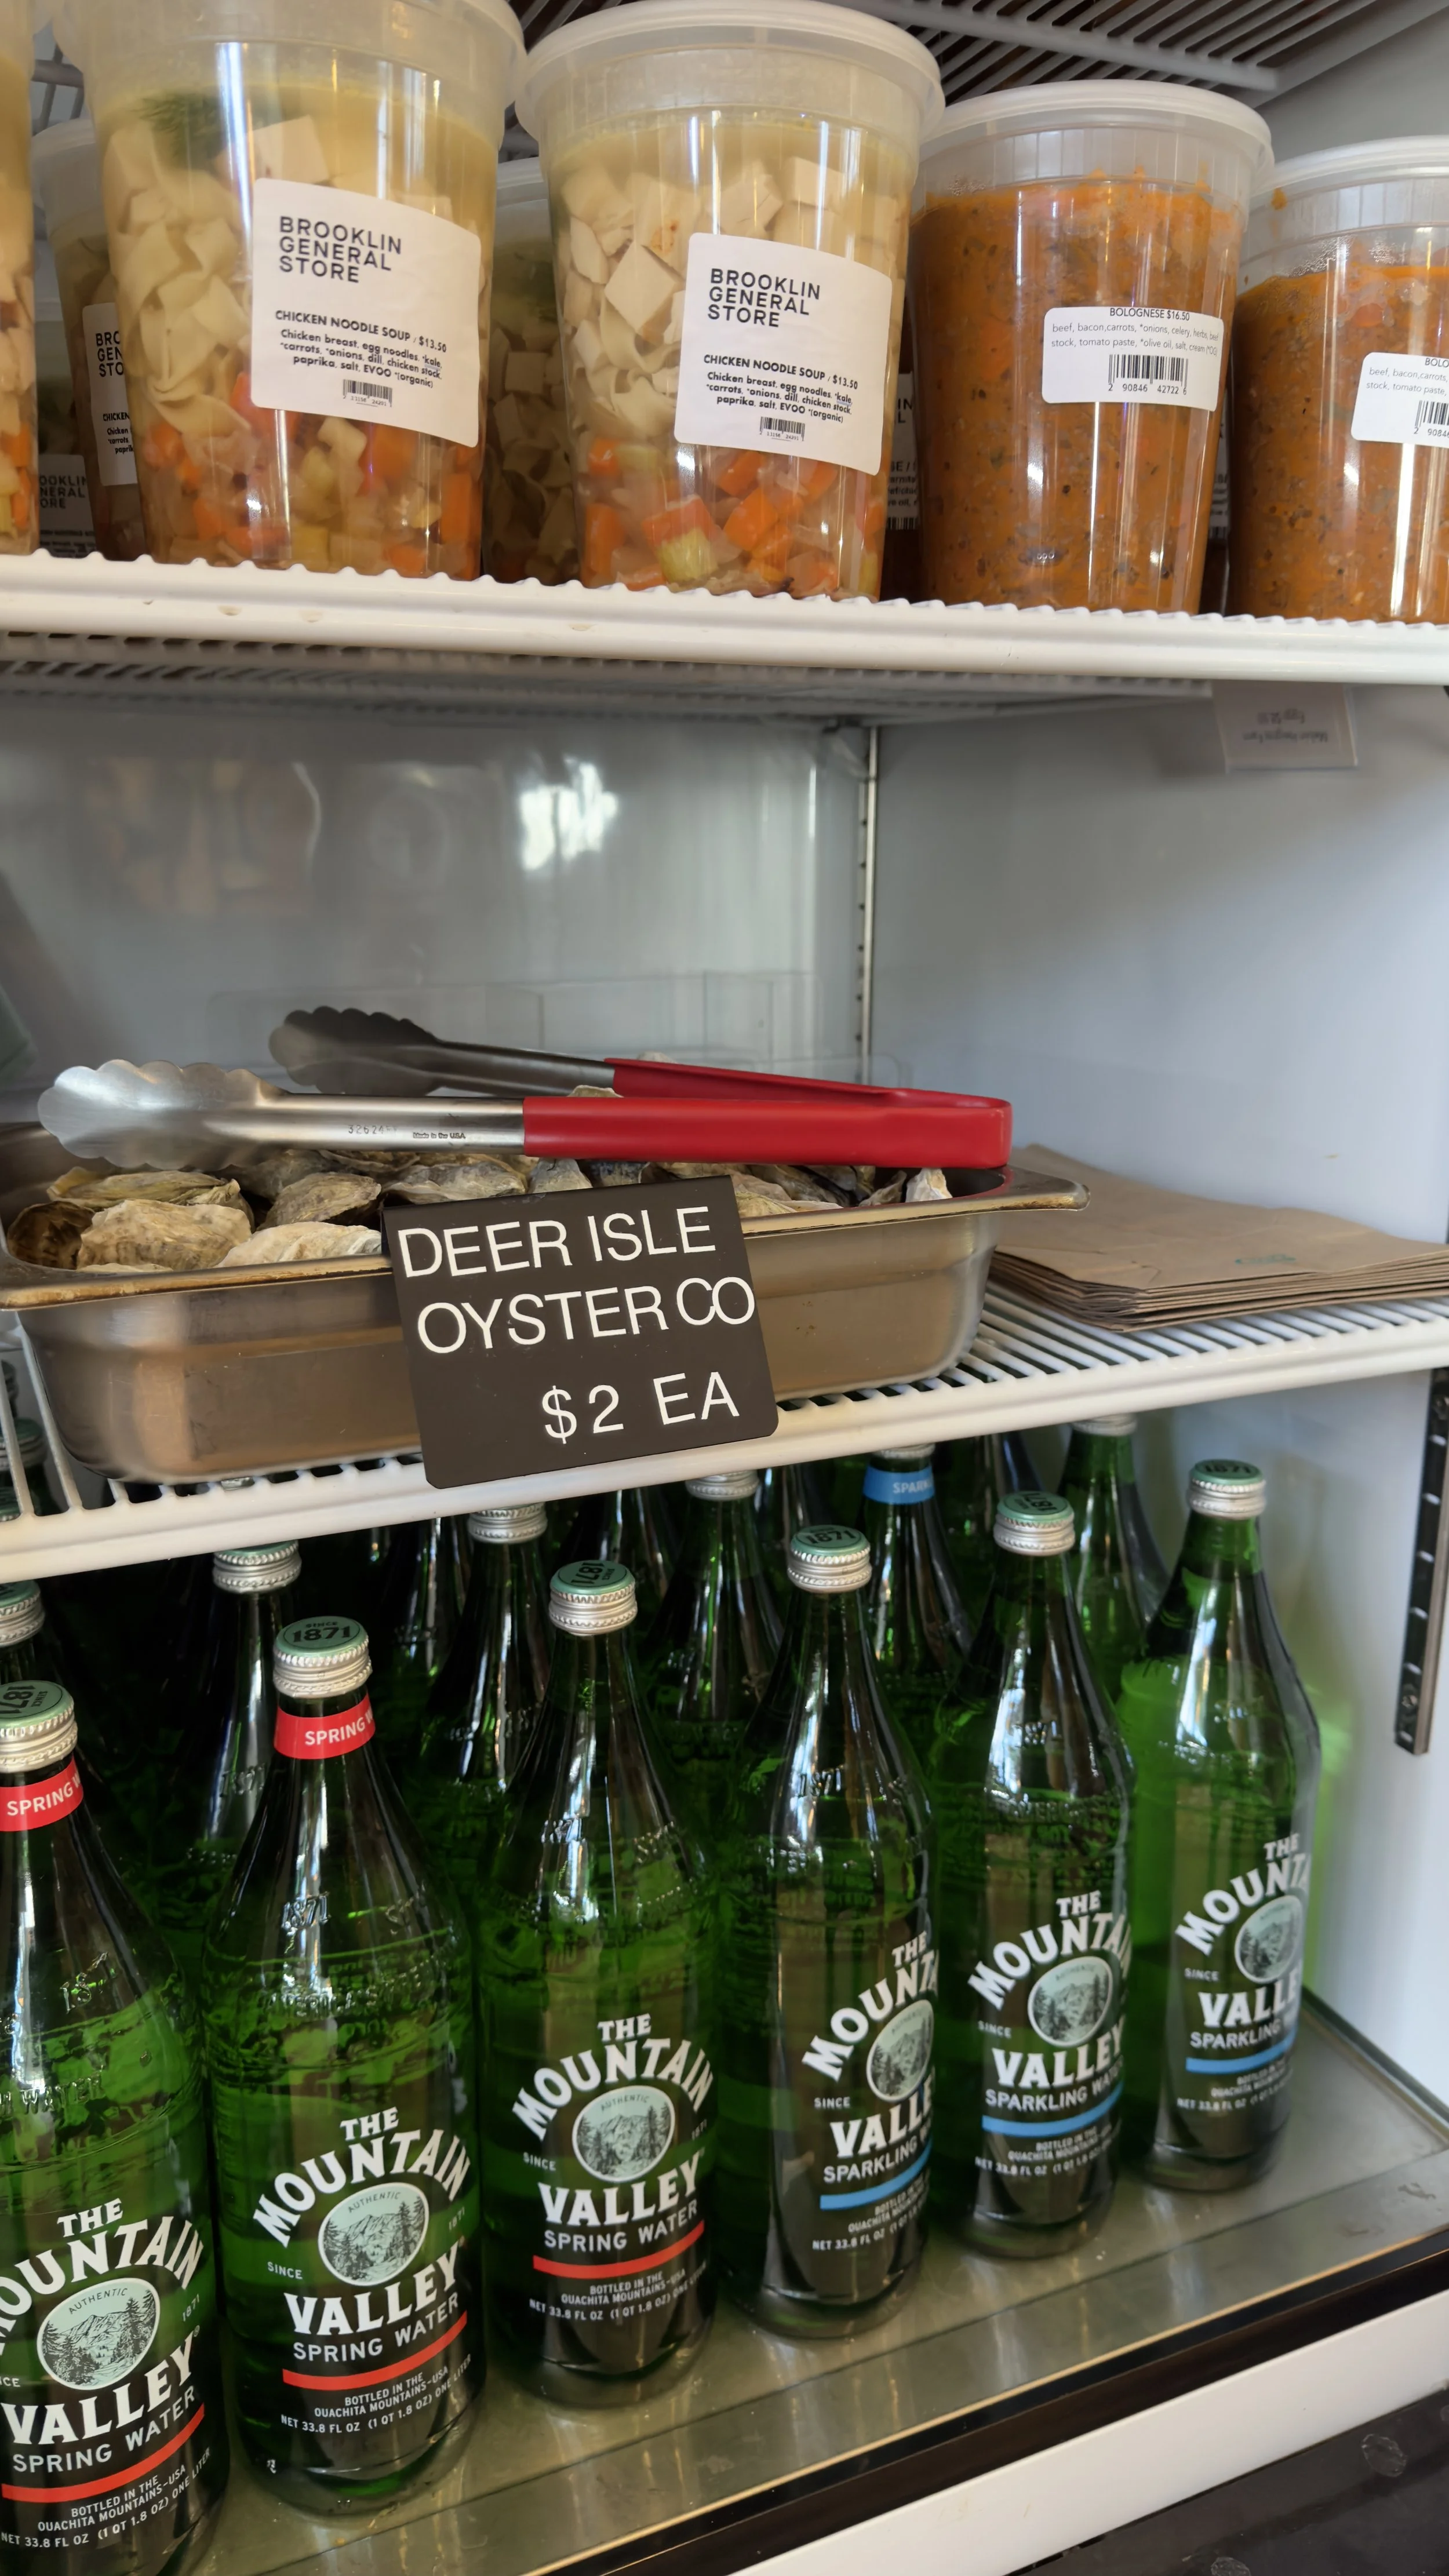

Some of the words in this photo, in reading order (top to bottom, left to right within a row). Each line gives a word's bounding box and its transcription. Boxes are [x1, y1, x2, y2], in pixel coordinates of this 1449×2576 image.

[279, 216, 402, 254] BROOKLIN
[279, 236, 392, 271] GENERAL
[279, 255, 359, 283] STORE
[710, 268, 821, 300] BROOKLIN
[709, 286, 810, 315] GENERAL
[1109, 308, 1164, 318] BOLOGNESE
[1167, 310, 1190, 321] $16.50
[708, 304, 780, 327] STORE
[275, 310, 327, 326] CHICKEN
[330, 317, 378, 335] NOODLE
[382, 326, 410, 341] SOUP
[419, 335, 447, 353] $13.50
[281, 329, 321, 343] Chicken
[325, 334, 359, 348] breast,
[362, 342, 381, 354] egg
[383, 346, 420, 362] noodles,
[1051, 338, 1076, 348] stock,
[1079, 338, 1110, 347] tomato
[1113, 338, 1137, 350] paste,
[1163, 340, 1173, 349] oil,
[1175, 342, 1187, 351] salt,
[1189, 344, 1205, 353] cream
[1052, 323, 1075, 333] beef,
[1171, 327, 1192, 338] celery,
[1193, 329, 1208, 341] herbs,
[293, 355, 337, 369] paprika,
[340, 361, 361, 373] salt,
[363, 365, 392, 378] EVOO
[368, 354, 384, 365] dill,
[387, 358, 419, 373] chicken
[421, 366, 442, 380] stock,
[704, 354, 750, 367] CHICKEN
[753, 360, 797, 375] NOODLE
[799, 367, 825, 381] SOUP
[832, 374, 858, 390] $13.50
[1369, 367, 1390, 377] beef,
[707, 371, 743, 384] Chicken
[747, 376, 778, 388] breast,
[780, 383, 797, 393] egg
[799, 386, 832, 399] noodles,
[1122, 384, 1148, 392] 90846
[1157, 385, 1179, 395] 42722
[1366, 381, 1389, 391] stock,
[1393, 384, 1421, 392] tomato
[1423, 387, 1447, 396] paste,
[716, 395, 756, 407] paprika,
[759, 400, 777, 410] salt,
[780, 403, 806, 414] EVOO
[784, 392, 800, 403] dill,
[802, 396, 832, 409] chicken
[833, 403, 852, 415] stock,
[107, 427, 129, 435] Chicken
[398, 1220, 573, 1278] DEER
[587, 1206, 716, 1262] ISLE
[417, 1285, 669, 1353] OYSTER
[676, 1276, 755, 1326] CO
[541, 1385, 624, 1444] $2
[653, 1371, 740, 1425] EA
[806, 1531, 857, 1544] 1871
[570, 1562, 605, 1584] 1871
[293, 1625, 350, 1642] 1871
[31, 1691, 48, 1707] SINCE
[305, 1717, 366, 1746] SPRING
[7, 1782, 74, 1816] SPRING
[1264, 1833, 1299, 1861] THE
[1055, 1890, 1101, 1918] THE
[891, 1930, 928, 1968] THE
[597, 2013, 651, 2043] THE
[1190, 2019, 1281, 2050] SPARKLING
[992, 2016, 1124, 2089] VALLEY
[512, 2038, 714, 2142] MOUNTAIN
[814, 2097, 850, 2109] SINCE
[985, 2086, 1087, 2111] SPARKLING
[340, 2106, 399, 2141] THE
[523, 2151, 556, 2171] SINCE
[824, 2135, 918, 2184] SPARKLING
[253, 2129, 471, 2248] MOUNTAIN
[348, 2191, 401, 2213] AUTHENTIC
[537, 2151, 701, 2227] VALLEY
[57, 2198, 123, 2237] THE
[544, 2229, 627, 2253] SPRING
[638, 2199, 697, 2245] WATER
[267, 2261, 303, 2280] SINCE
[589, 2281, 631, 2296] BOTTLED
[634, 2277, 645, 2288] IN
[646, 2271, 663, 2284] THE
[69, 2288, 128, 2314] AUTHENTIC
[283, 2240, 459, 2335] VALLEY
[561, 2293, 609, 2305] OUACHITA
[182, 2293, 200, 2322] 1871
[293, 2338, 383, 2363] SPRING
[394, 2291, 458, 2347] WATER
[1, 2330, 194, 2445] VALLEY
[281, 2414, 298, 2428] NET
[301, 2421, 326, 2433] 33.8
[329, 2424, 342, 2433] FL
[347, 2422, 360, 2432] OZ
[368, 2418, 377, 2429] (1
[381, 2413, 394, 2425] QT
[398, 2404, 413, 2419] 1.8
[416, 2394, 432, 2410] OZ)
[435, 2378, 452, 2398] ONE
[453, 2353, 472, 2381] LITER
[345, 2388, 389, 2407] BOTTLED
[392, 2382, 403, 2395] IN
[406, 2372, 424, 2386] THE
[314, 2403, 366, 2418] OUACHITA
[13, 2444, 112, 2473] SPRING
[125, 2385, 195, 2451] WATER
[1, 2531, 20, 2545] NET
[24, 2537, 50, 2548] 33.8
[54, 2538, 69, 2548] FL
[74, 2533, 89, 2544] OZ
[97, 2527, 108, 2540] (1
[112, 2521, 127, 2534] QT
[132, 2511, 147, 2527] 1.8
[151, 2496, 169, 2515] OZ)
[172, 2476, 190, 2499] ONE
[192, 2447, 210, 2479] LITER
[71, 2496, 120, 2517] BOTTLED
[124, 2488, 136, 2502] IN
[139, 2475, 159, 2491] THE
[38, 2516, 95, 2532] OUACHITA
